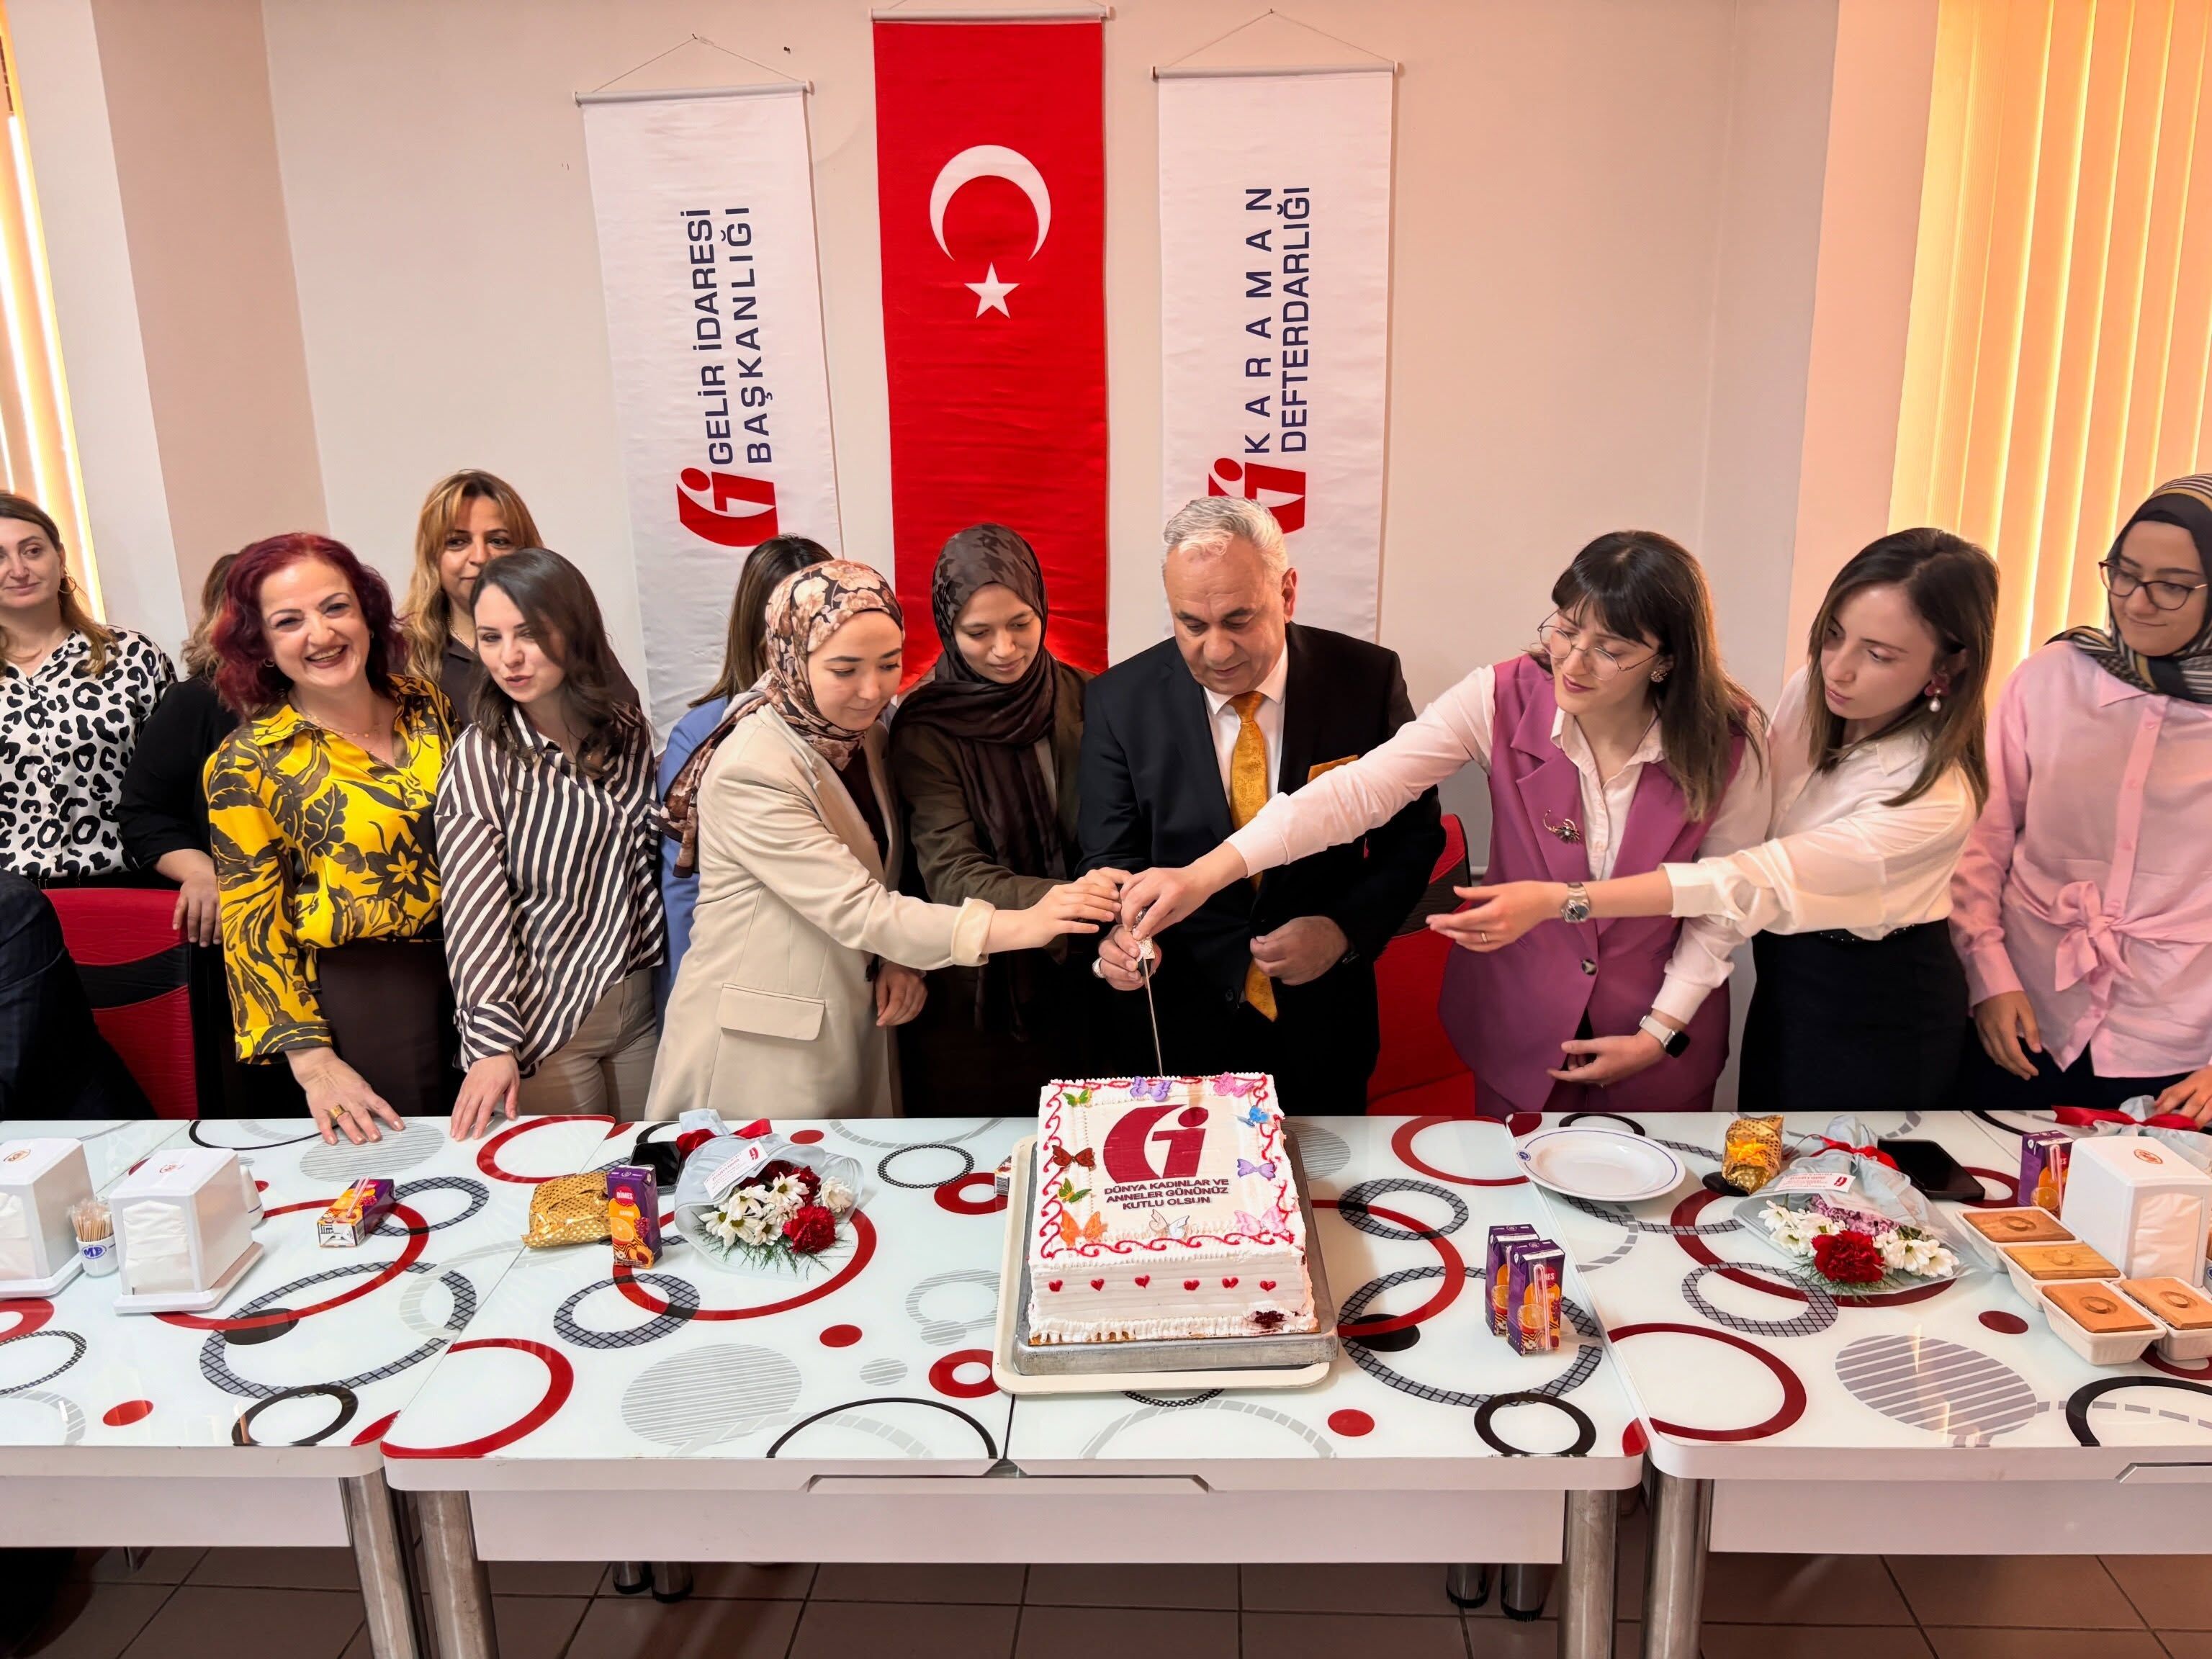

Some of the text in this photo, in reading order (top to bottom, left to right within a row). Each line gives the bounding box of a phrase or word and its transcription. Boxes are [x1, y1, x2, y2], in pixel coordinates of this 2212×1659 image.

[680, 209, 733, 465] GELİR İDARESİ
[721, 207, 773, 464] BAŞKANLIĞI
[1277, 187, 1310, 452] DEFTERDARLIĞI
[1104, 1184, 1148, 1195] DÜNYA
[1149, 1179, 1211, 1190] KADINLAR
[1106, 1187, 1229, 1203] ANNELER GÜNÜNÜZ
[1123, 1196, 1210, 1210] KUTLU OLSUN
